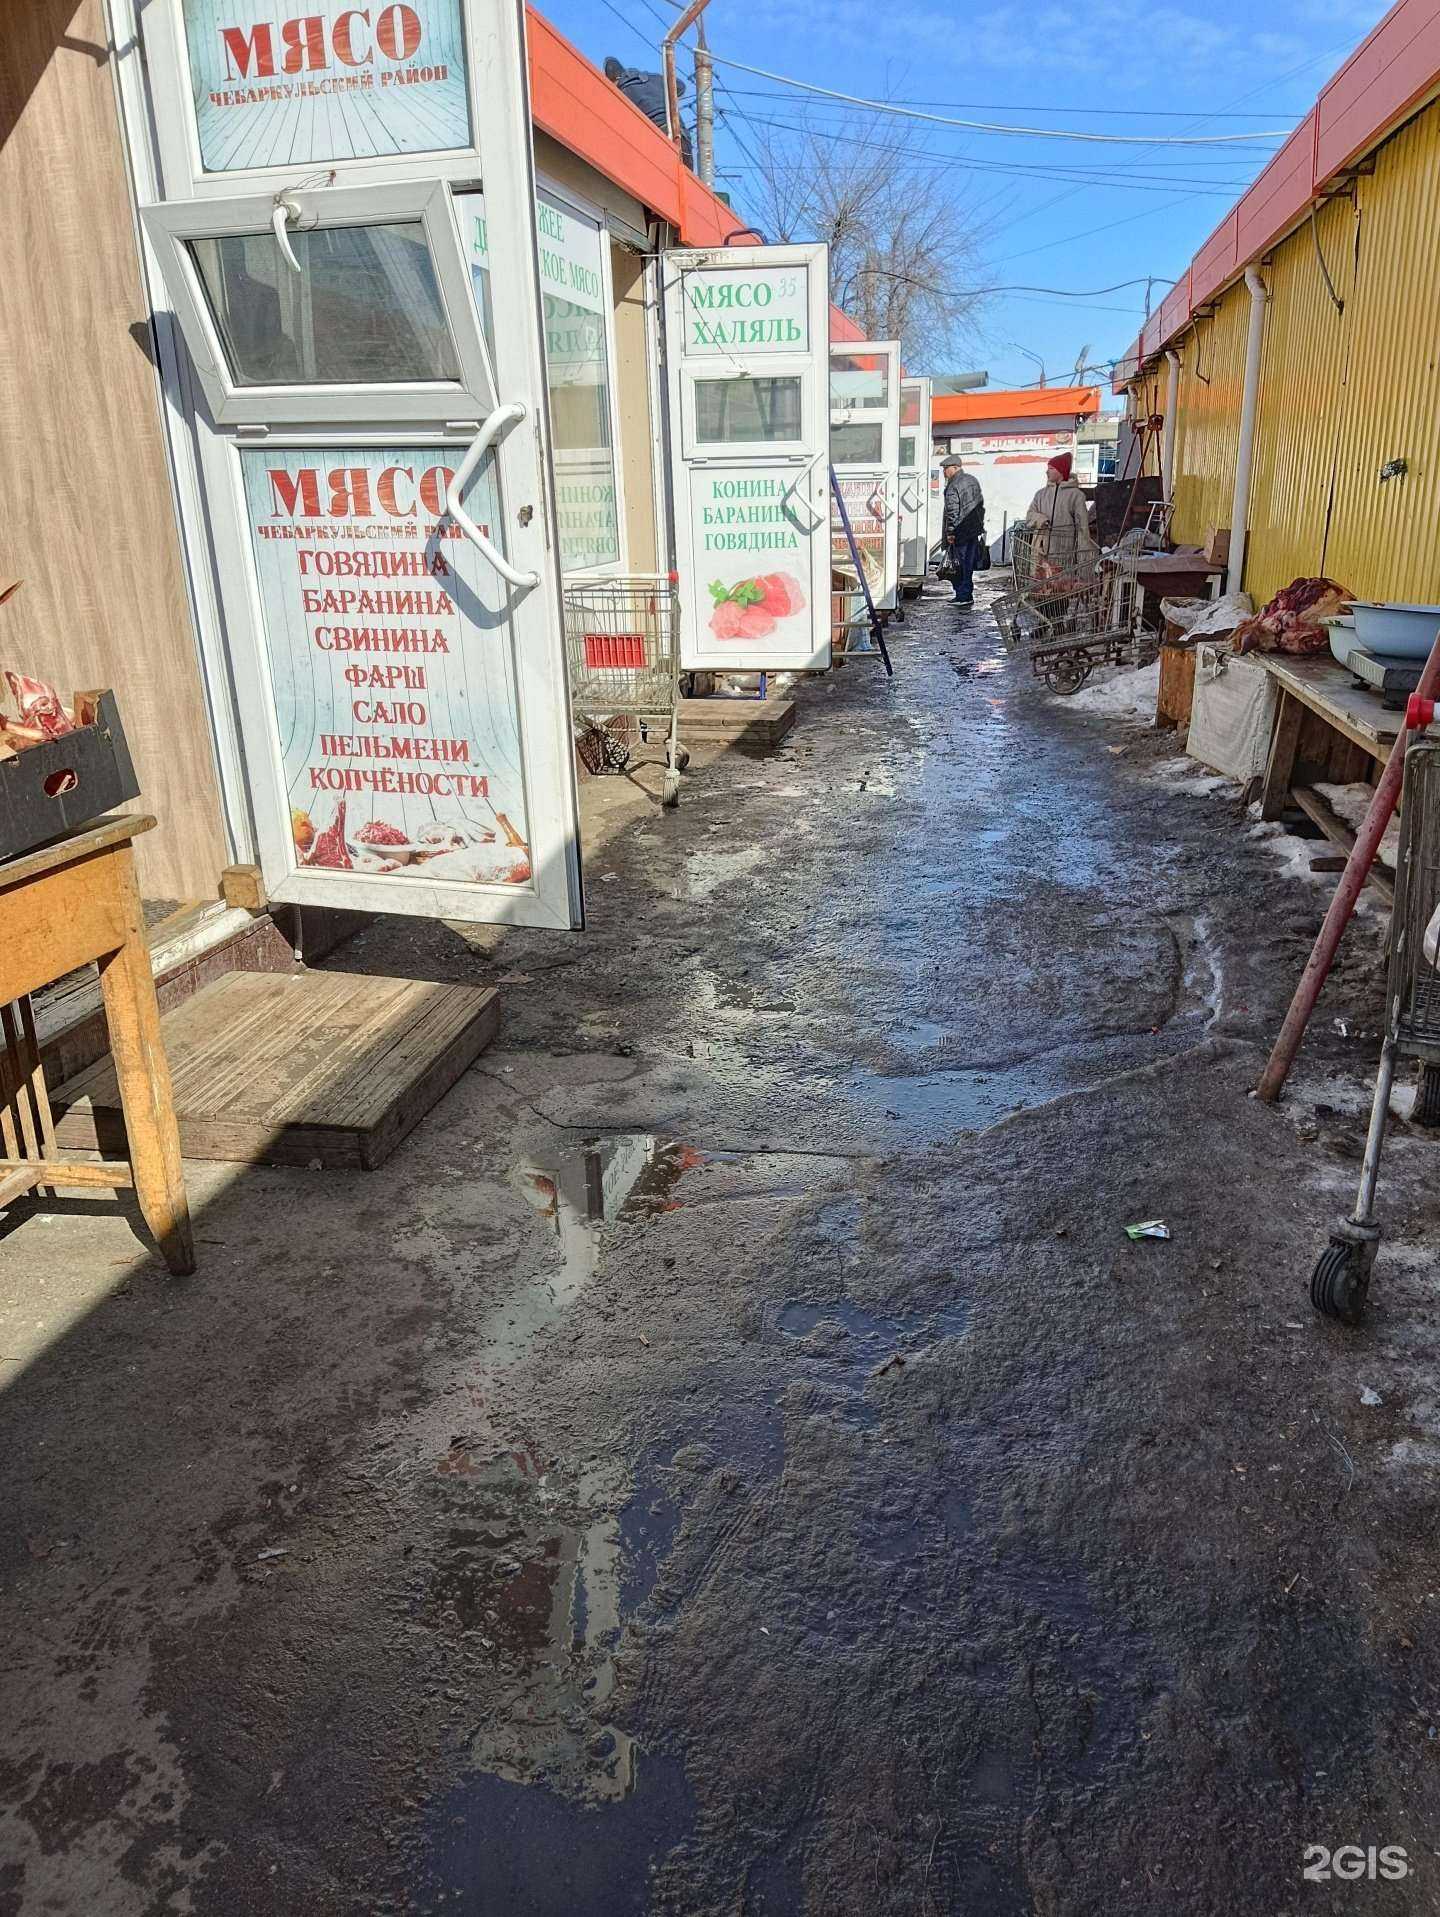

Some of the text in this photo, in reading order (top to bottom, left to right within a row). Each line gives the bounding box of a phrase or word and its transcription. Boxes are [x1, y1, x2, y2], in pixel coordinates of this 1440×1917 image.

[218, 4, 422, 82] МЯСО
[208, 61, 449, 107] ЧЕБАРКУЛЬСКИЙ РАЙОН
[538, 203, 565, 242] ЖЕЕ
[540, 248, 599, 298] КОЕ МЯСО
[692, 283, 772, 309] МЯСО
[692, 319, 801, 345] ХАЛЯЛЬ
[265, 466, 464, 518] МЯСО
[712, 480, 788, 498] КОНИНА
[703, 506, 798, 524] БАРАНИНА
[257, 521, 418, 540] ЧЕБАРКУЛЬСКИЙ
[704, 532, 798, 552] ГОВЯДИНА
[298, 550, 450, 578] ГОВЯДИНА
[303, 589, 455, 615] БАРАНИНА
[314, 626, 450, 653] СВИНИНА
[344, 664, 427, 689] ФАРШ
[352, 700, 427, 725] САЛО
[320, 734, 470, 762] ПЕЛЬМЕНИ
[309, 766, 489, 798] КОПЧЁНОСТИ
